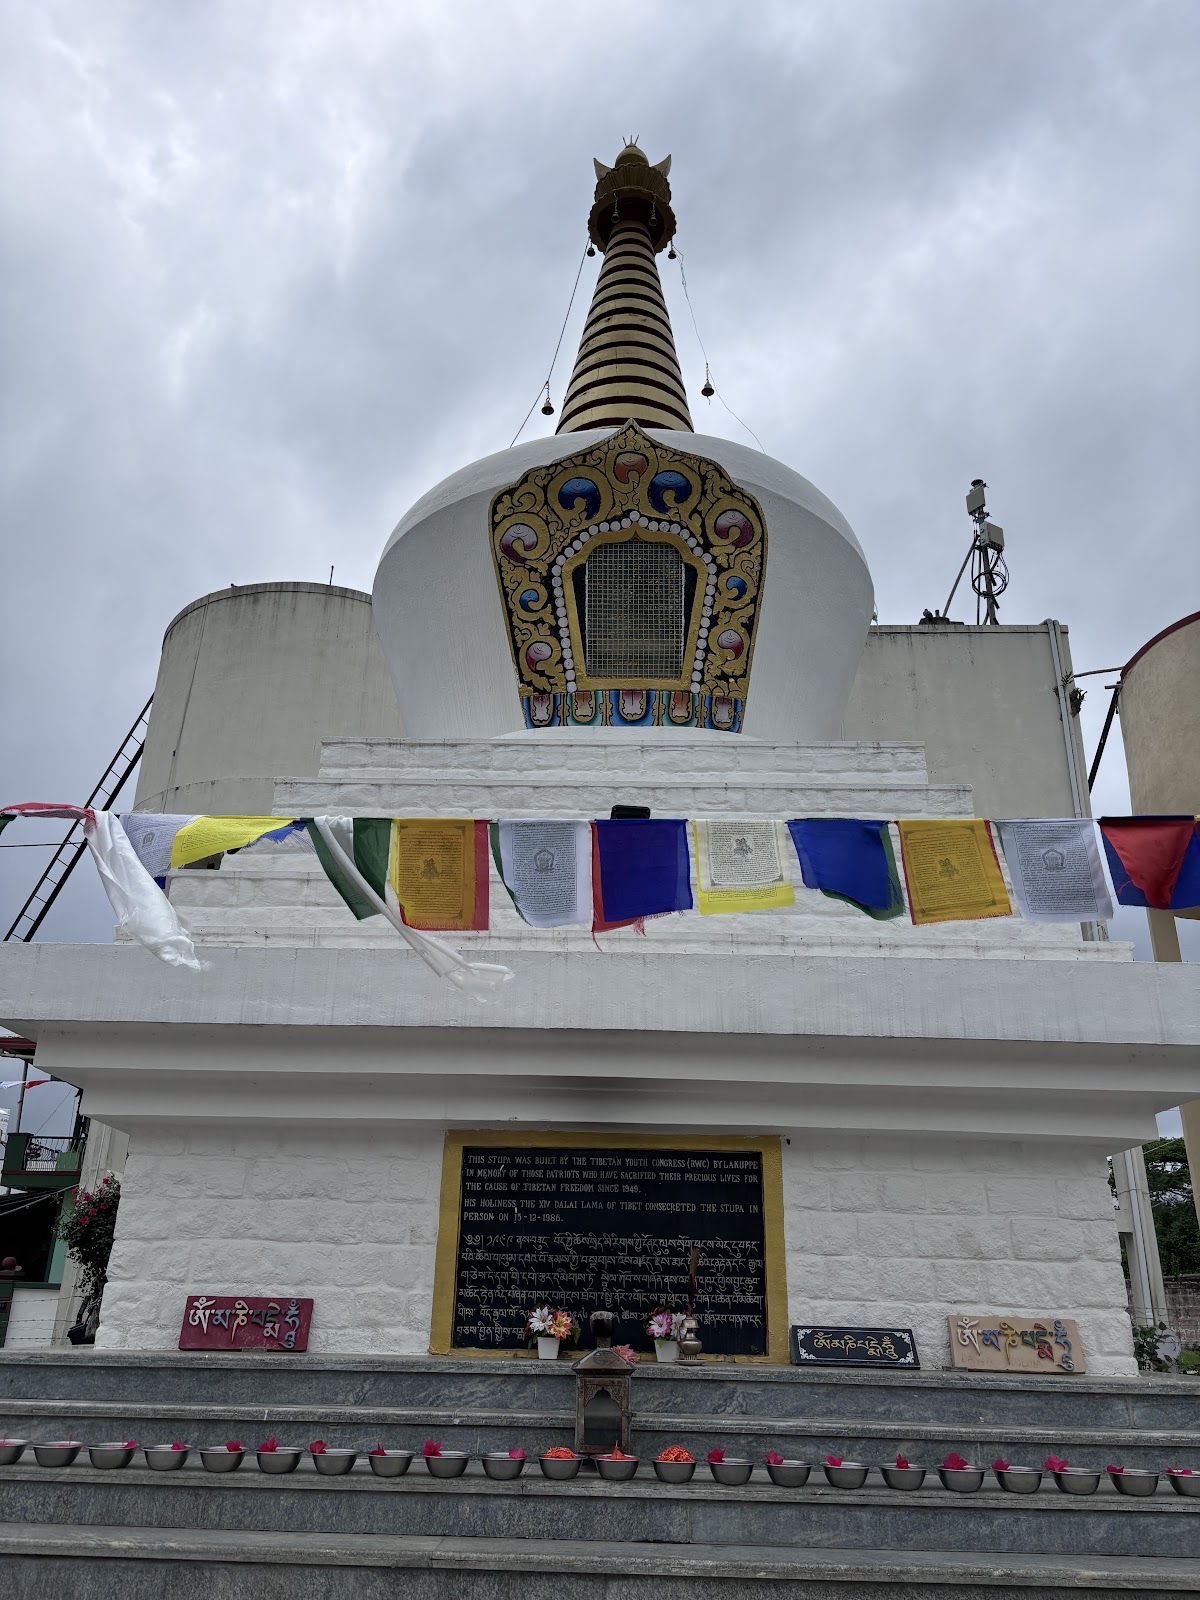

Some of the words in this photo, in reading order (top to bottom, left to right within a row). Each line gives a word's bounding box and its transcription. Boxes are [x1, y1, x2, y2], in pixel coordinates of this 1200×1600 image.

[468, 1155, 485, 1164] THIS
[488, 1156, 511, 1164] STUPA
[515, 1156, 531, 1164] WAS
[535, 1157, 556, 1165] BUILT
[560, 1157, 568, 1165] BY
[572, 1158, 587, 1166] THE
[590, 1158, 622, 1166] TIBETAN
[625, 1158, 648, 1166] YOUTH
[652, 1159, 685, 1168] CONGRESS
[713, 1160, 758, 1169] BYLAKUPPE
[466, 1169, 474, 1177] IN
[477, 1169, 506, 1177] MEMORY
[509, 1170, 518, 1178] OF
[522, 1170, 544, 1178] THOSE
[547, 1170, 580, 1178] PATRIOTS
[600, 1171, 618, 1179] HAVE
[620, 1172, 656, 1180] SACRIFIED
[660, 1172, 681, 1180] THEIR
[684, 1173, 716, 1182] PRECIOUS
[720, 1174, 740, 1182] LIVES
[466, 1182, 481, 1190] THE
[484, 1182, 507, 1190] CAUSE
[523, 1183, 556, 1191] TIBETAN
[560, 1184, 594, 1192] FREEDOM
[598, 1184, 619, 1192] SINCE
[622, 1185, 641, 1193] 1949.
[464, 1199, 476, 1207] HIS
[480, 1199, 516, 1208] HOLINESS
[520, 1200, 536, 1208] THE
[539, 1200, 550, 1208] XIV
[581, 1201, 603, 1209] LAMA
[620, 1202, 642, 1210] TIBET
[700, 1204, 716, 1212] THE
[720, 1204, 744, 1212] STUPA
[750, 1205, 758, 1213] IN
[464, 1212, 494, 1220] PERSON
